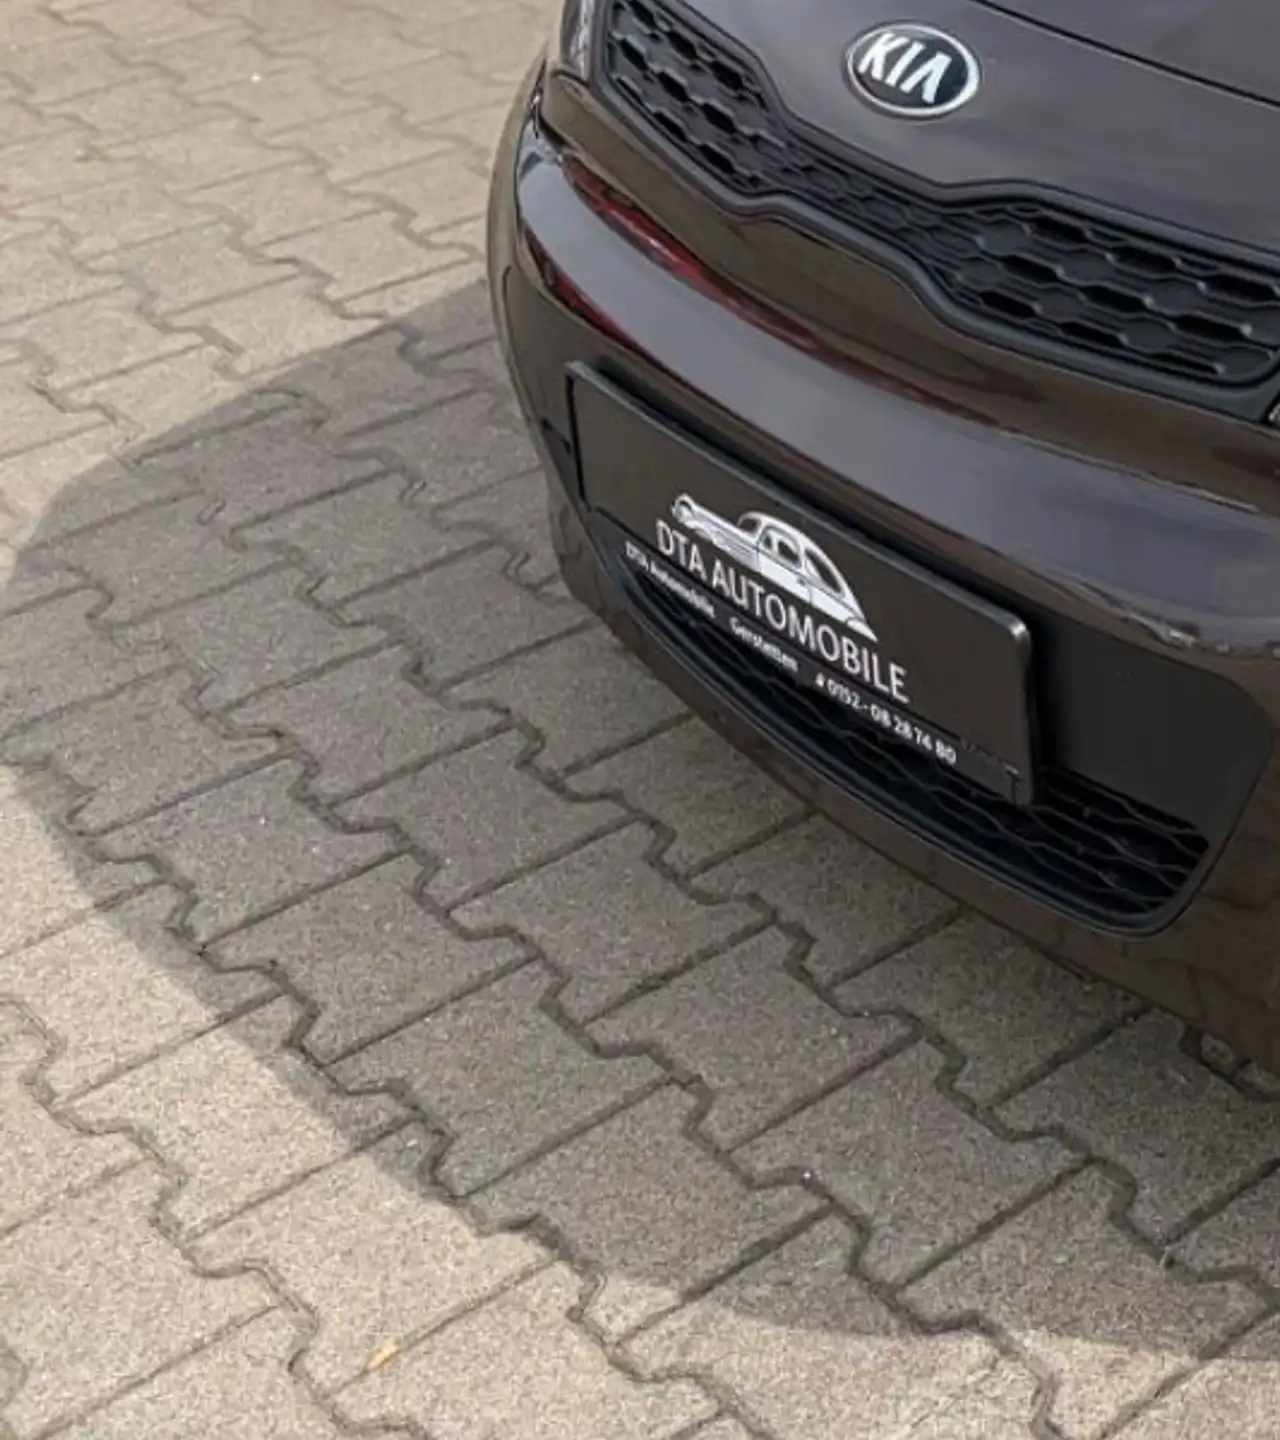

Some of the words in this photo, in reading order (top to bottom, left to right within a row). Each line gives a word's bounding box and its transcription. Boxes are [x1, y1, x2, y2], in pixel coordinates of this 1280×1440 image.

[858, 30, 952, 104] KIA
[655, 519, 708, 582] DTA
[711, 559, 910, 704] AUTOMOBILE
